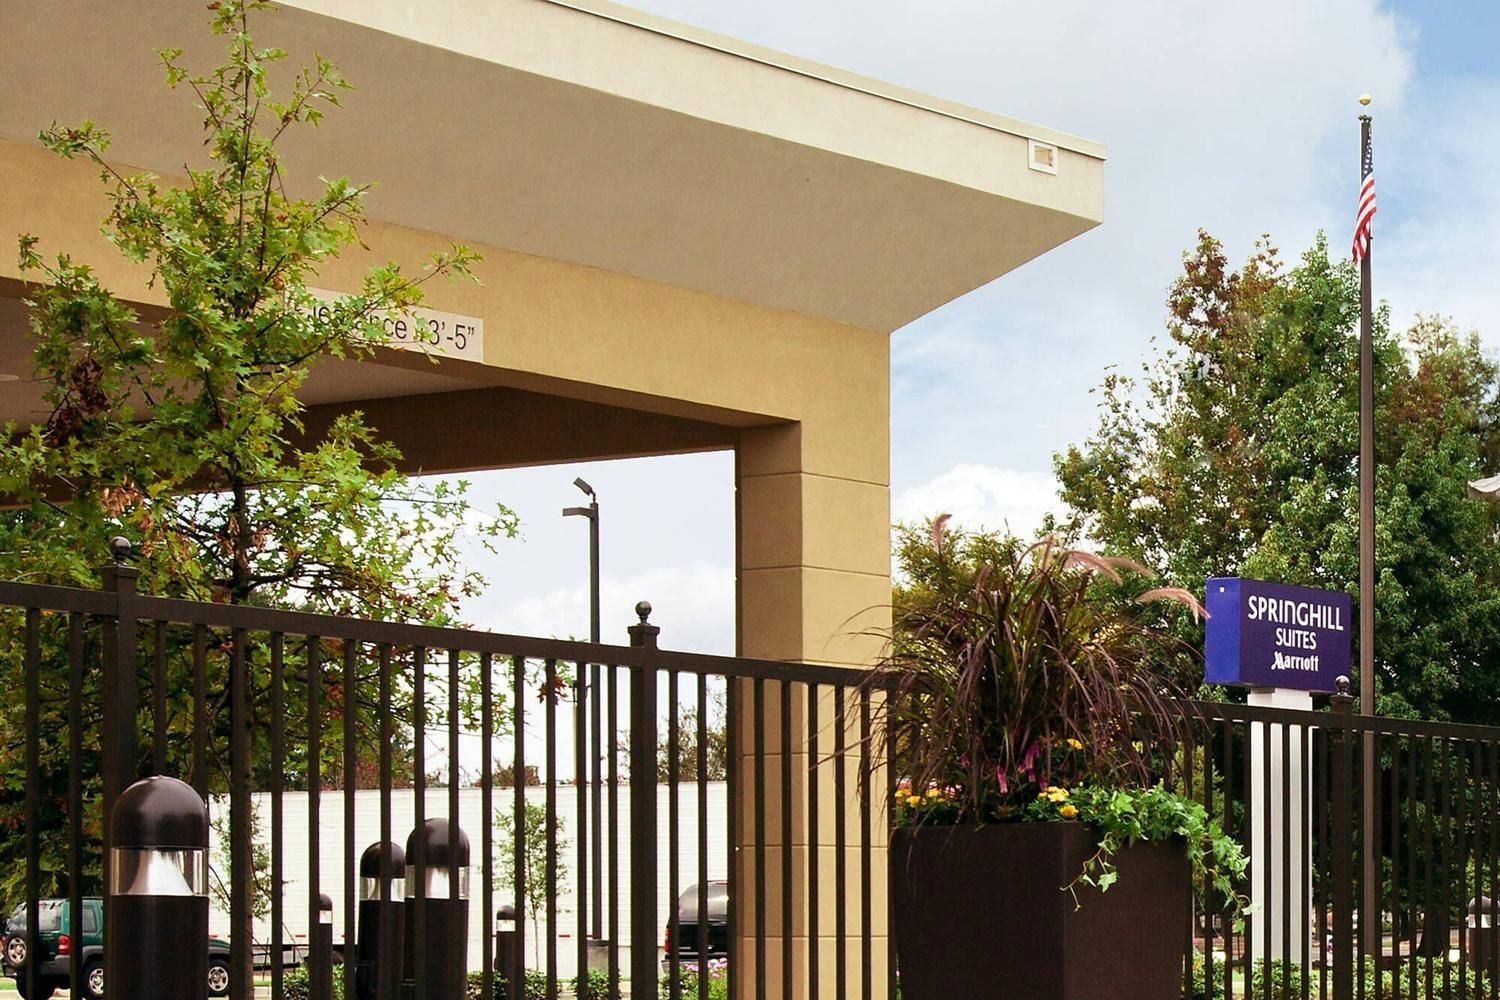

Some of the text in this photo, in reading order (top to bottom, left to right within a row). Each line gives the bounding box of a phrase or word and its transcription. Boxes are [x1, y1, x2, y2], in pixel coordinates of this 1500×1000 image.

[1247, 594, 1344, 631] SPRINGHILL
[1275, 627, 1317, 650] SUITES
[1270, 650, 1319, 672] Marriott
